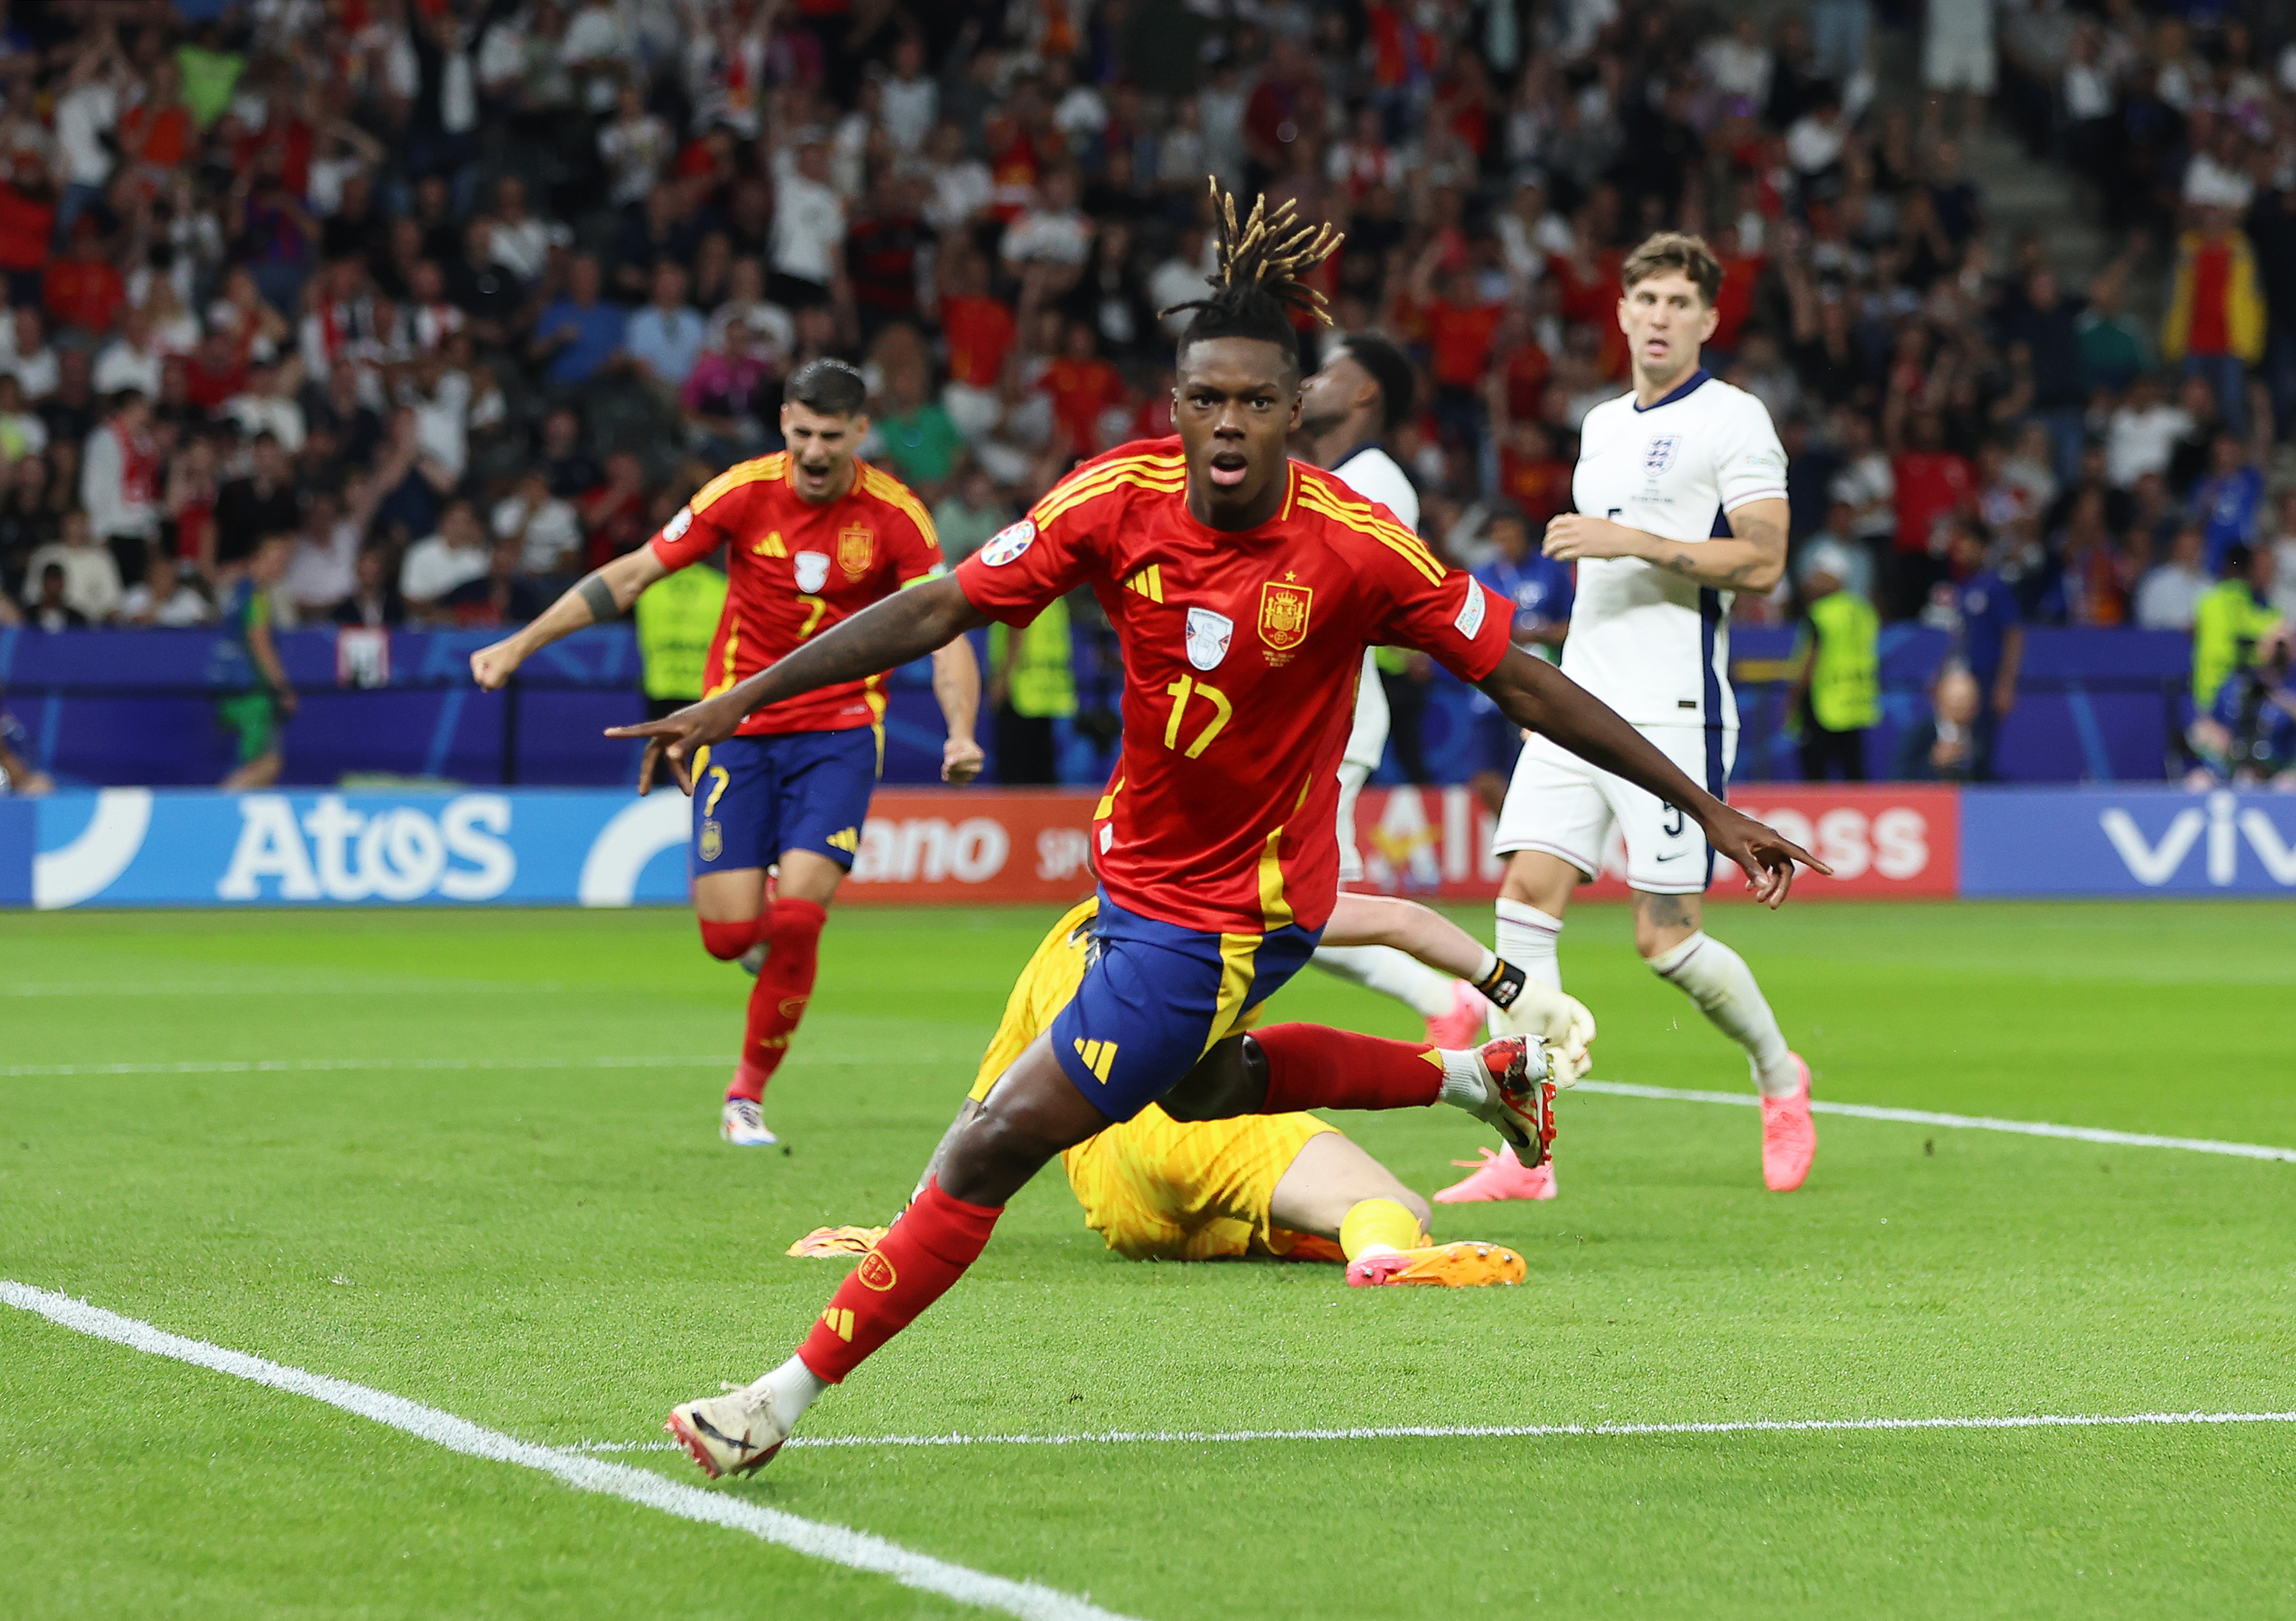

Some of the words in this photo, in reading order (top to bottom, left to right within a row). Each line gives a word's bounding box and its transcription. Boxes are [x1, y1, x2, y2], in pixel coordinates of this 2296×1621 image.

[797, 594, 827, 639] 7
[1164, 673, 1232, 759] 17
[704, 766, 729, 817] 7
